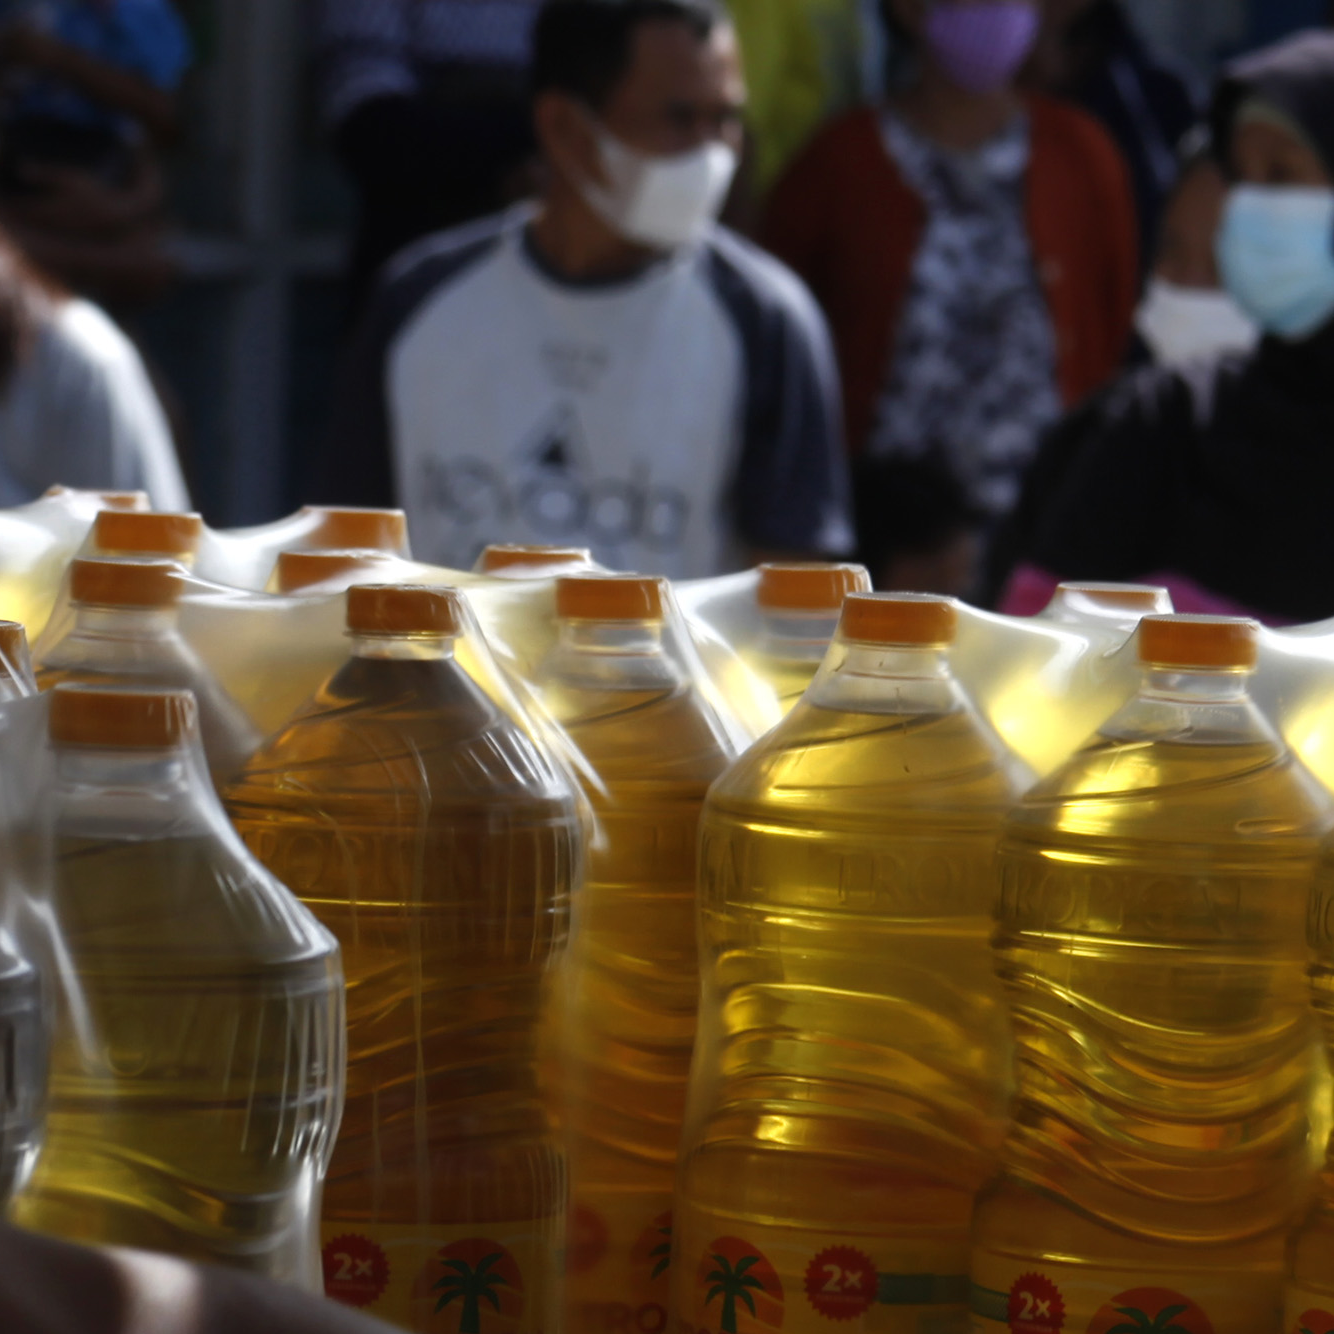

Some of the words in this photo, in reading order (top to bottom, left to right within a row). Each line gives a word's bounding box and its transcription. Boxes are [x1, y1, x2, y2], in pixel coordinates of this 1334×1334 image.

[333, 1252, 373, 1281] 2x
[821, 1263, 864, 1293] 2x
[1017, 1291, 1052, 1321] 2x
